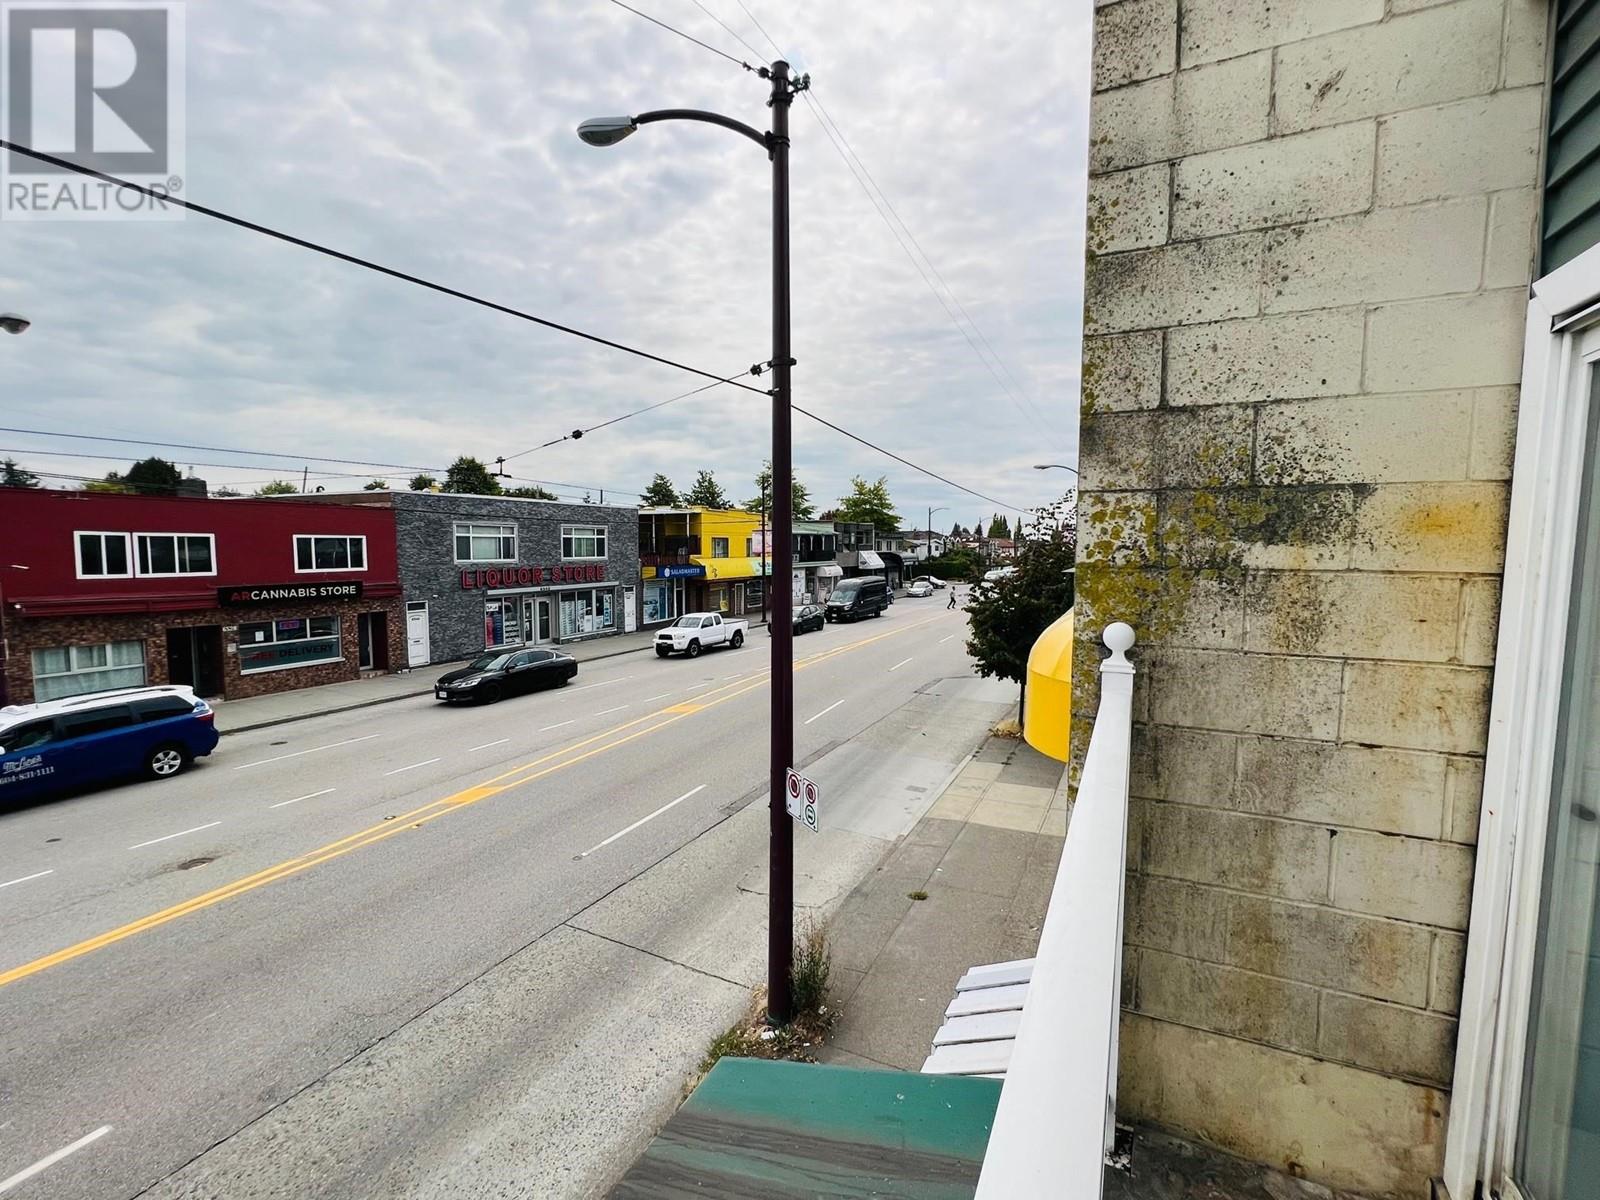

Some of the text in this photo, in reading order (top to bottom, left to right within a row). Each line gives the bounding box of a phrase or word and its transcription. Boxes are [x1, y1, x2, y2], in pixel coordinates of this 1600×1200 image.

[462, 565, 607, 589] LIQUOR STORE
[319, 585, 357, 597] STORE
[280, 644, 333, 657] DELIVERY
